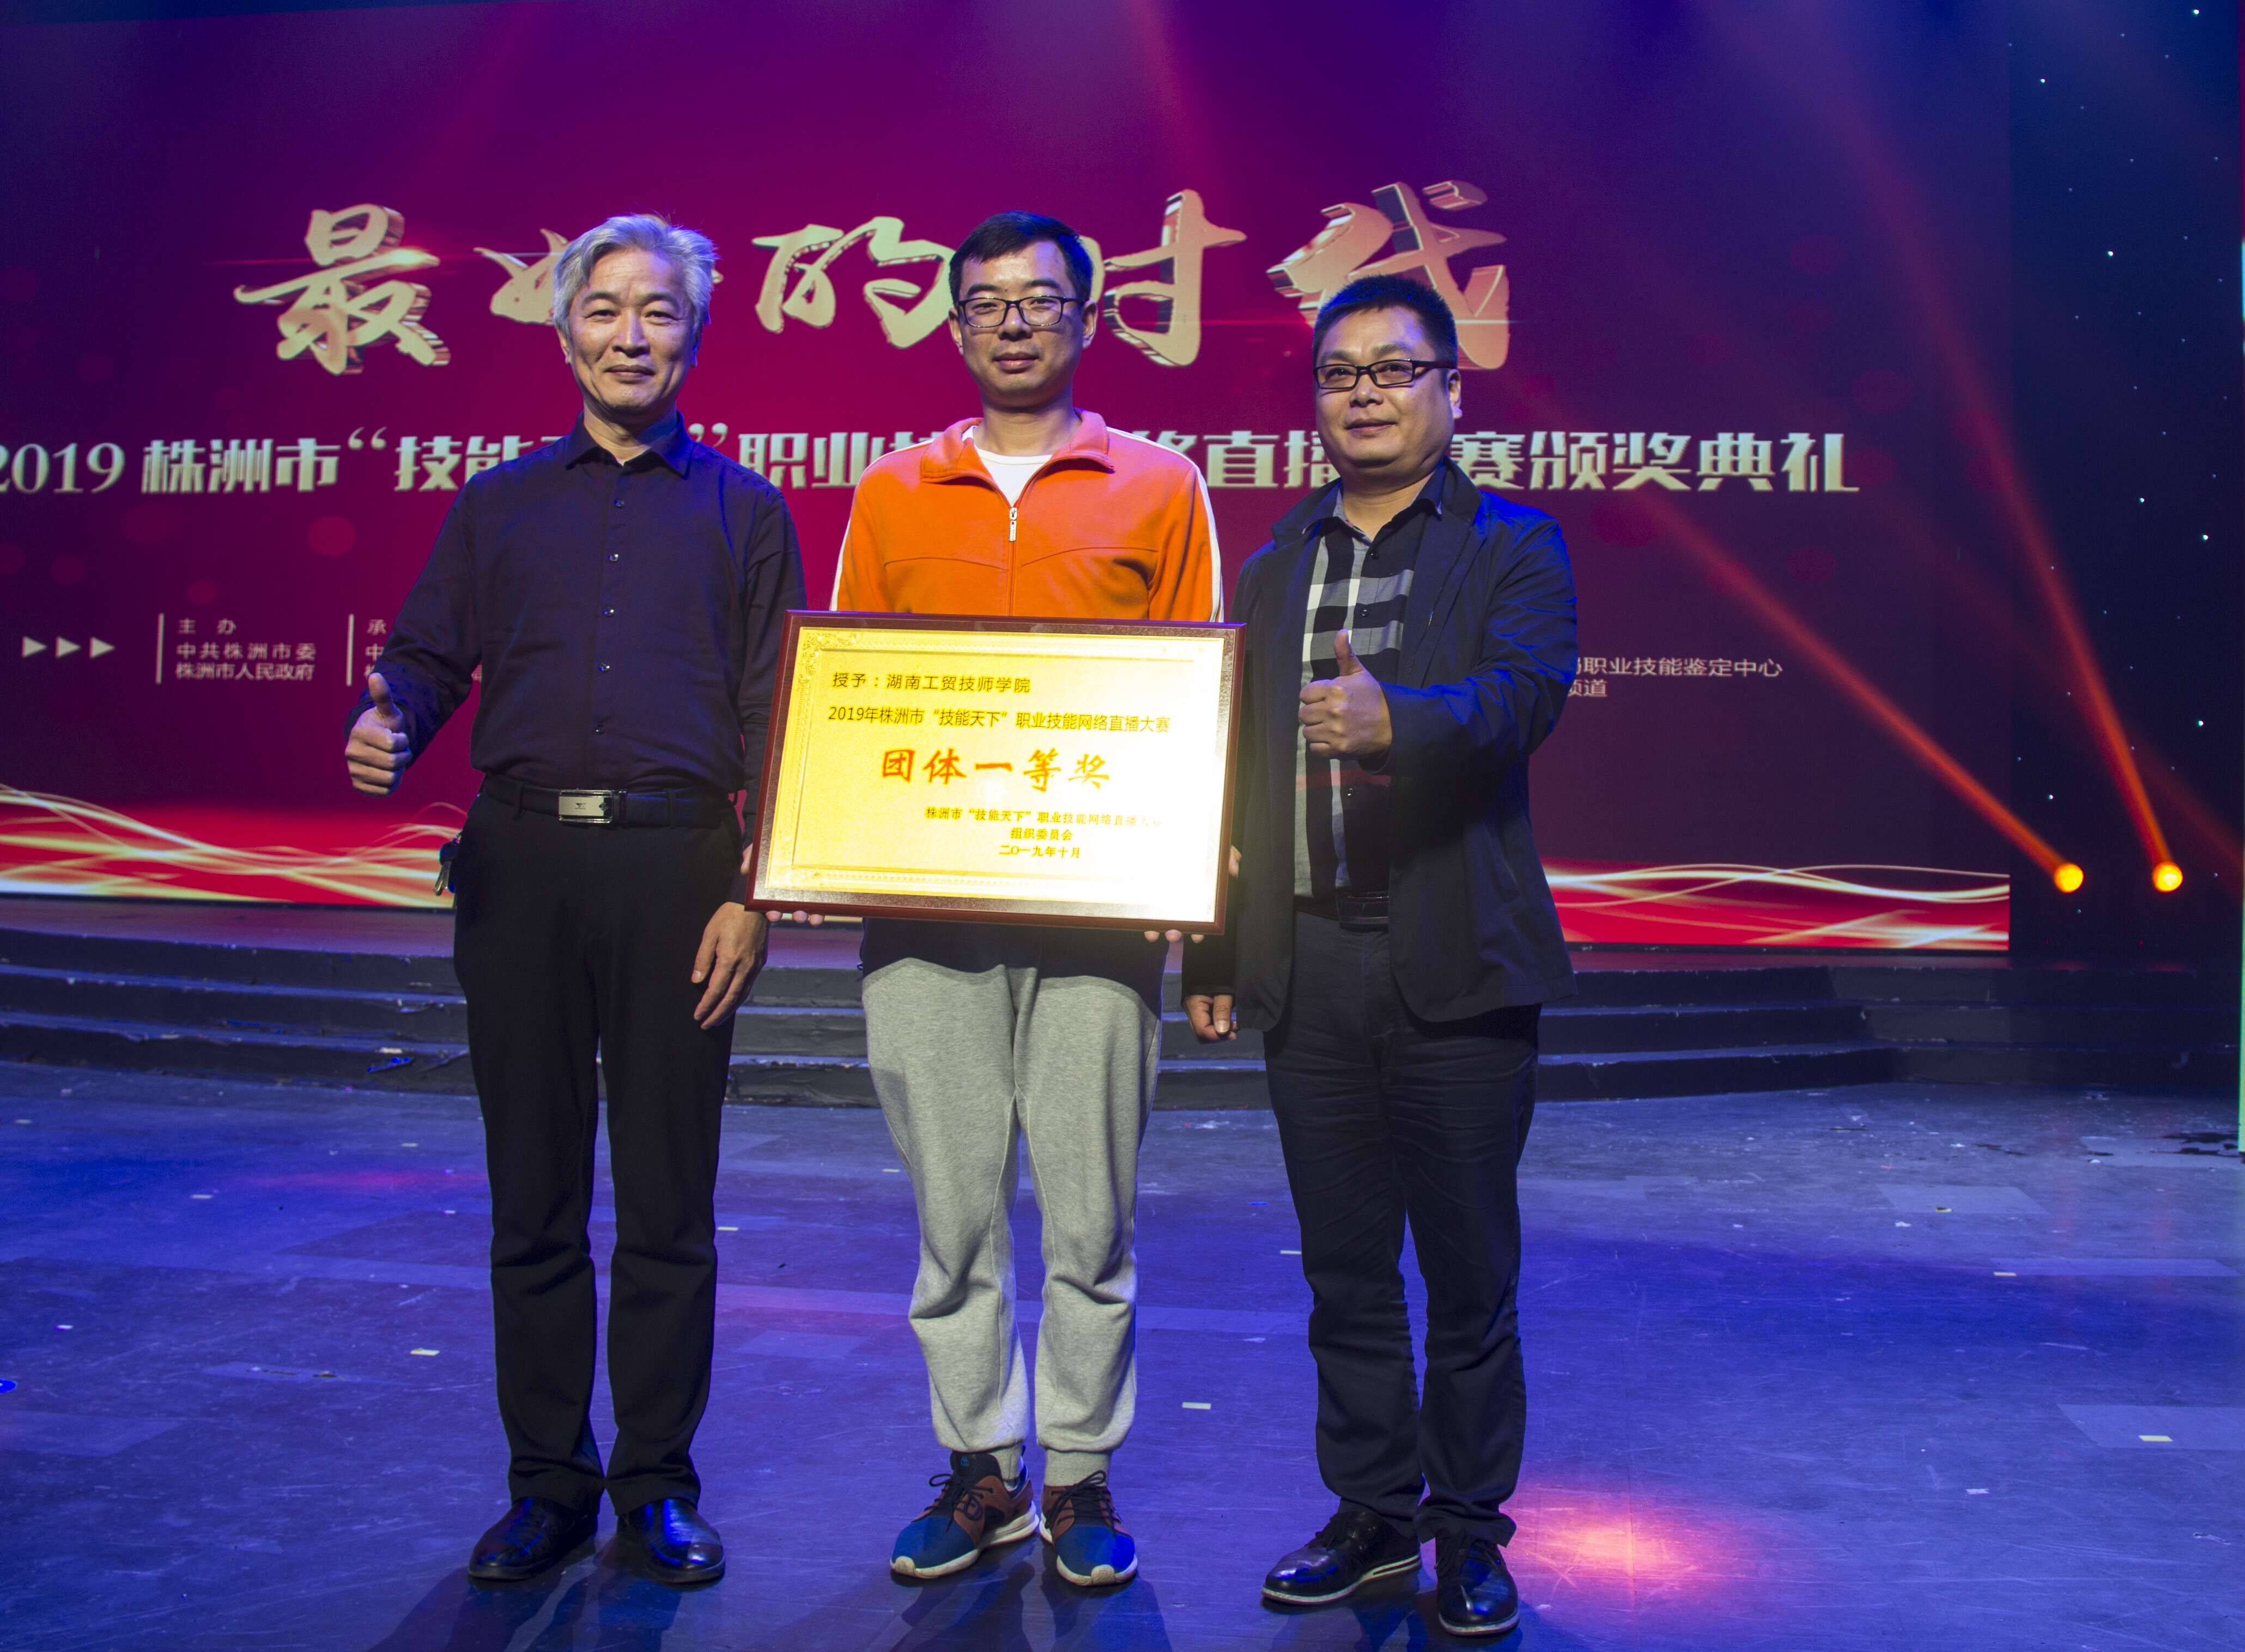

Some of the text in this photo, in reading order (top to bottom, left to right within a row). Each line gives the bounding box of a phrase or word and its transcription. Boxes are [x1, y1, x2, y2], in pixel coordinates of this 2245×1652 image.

[175, 642, 317, 661] 中共株洲市委
[175, 661, 315, 681] 株洲市人民政府
[1576, 656, 1783, 678] 职业技能鉴定中心
[832, 672, 1031, 694] 授予：湖南工贸技师学院
[881, 747, 1110, 792] 团体一等奖
[1010, 827, 1073, 841] 组织委员会
